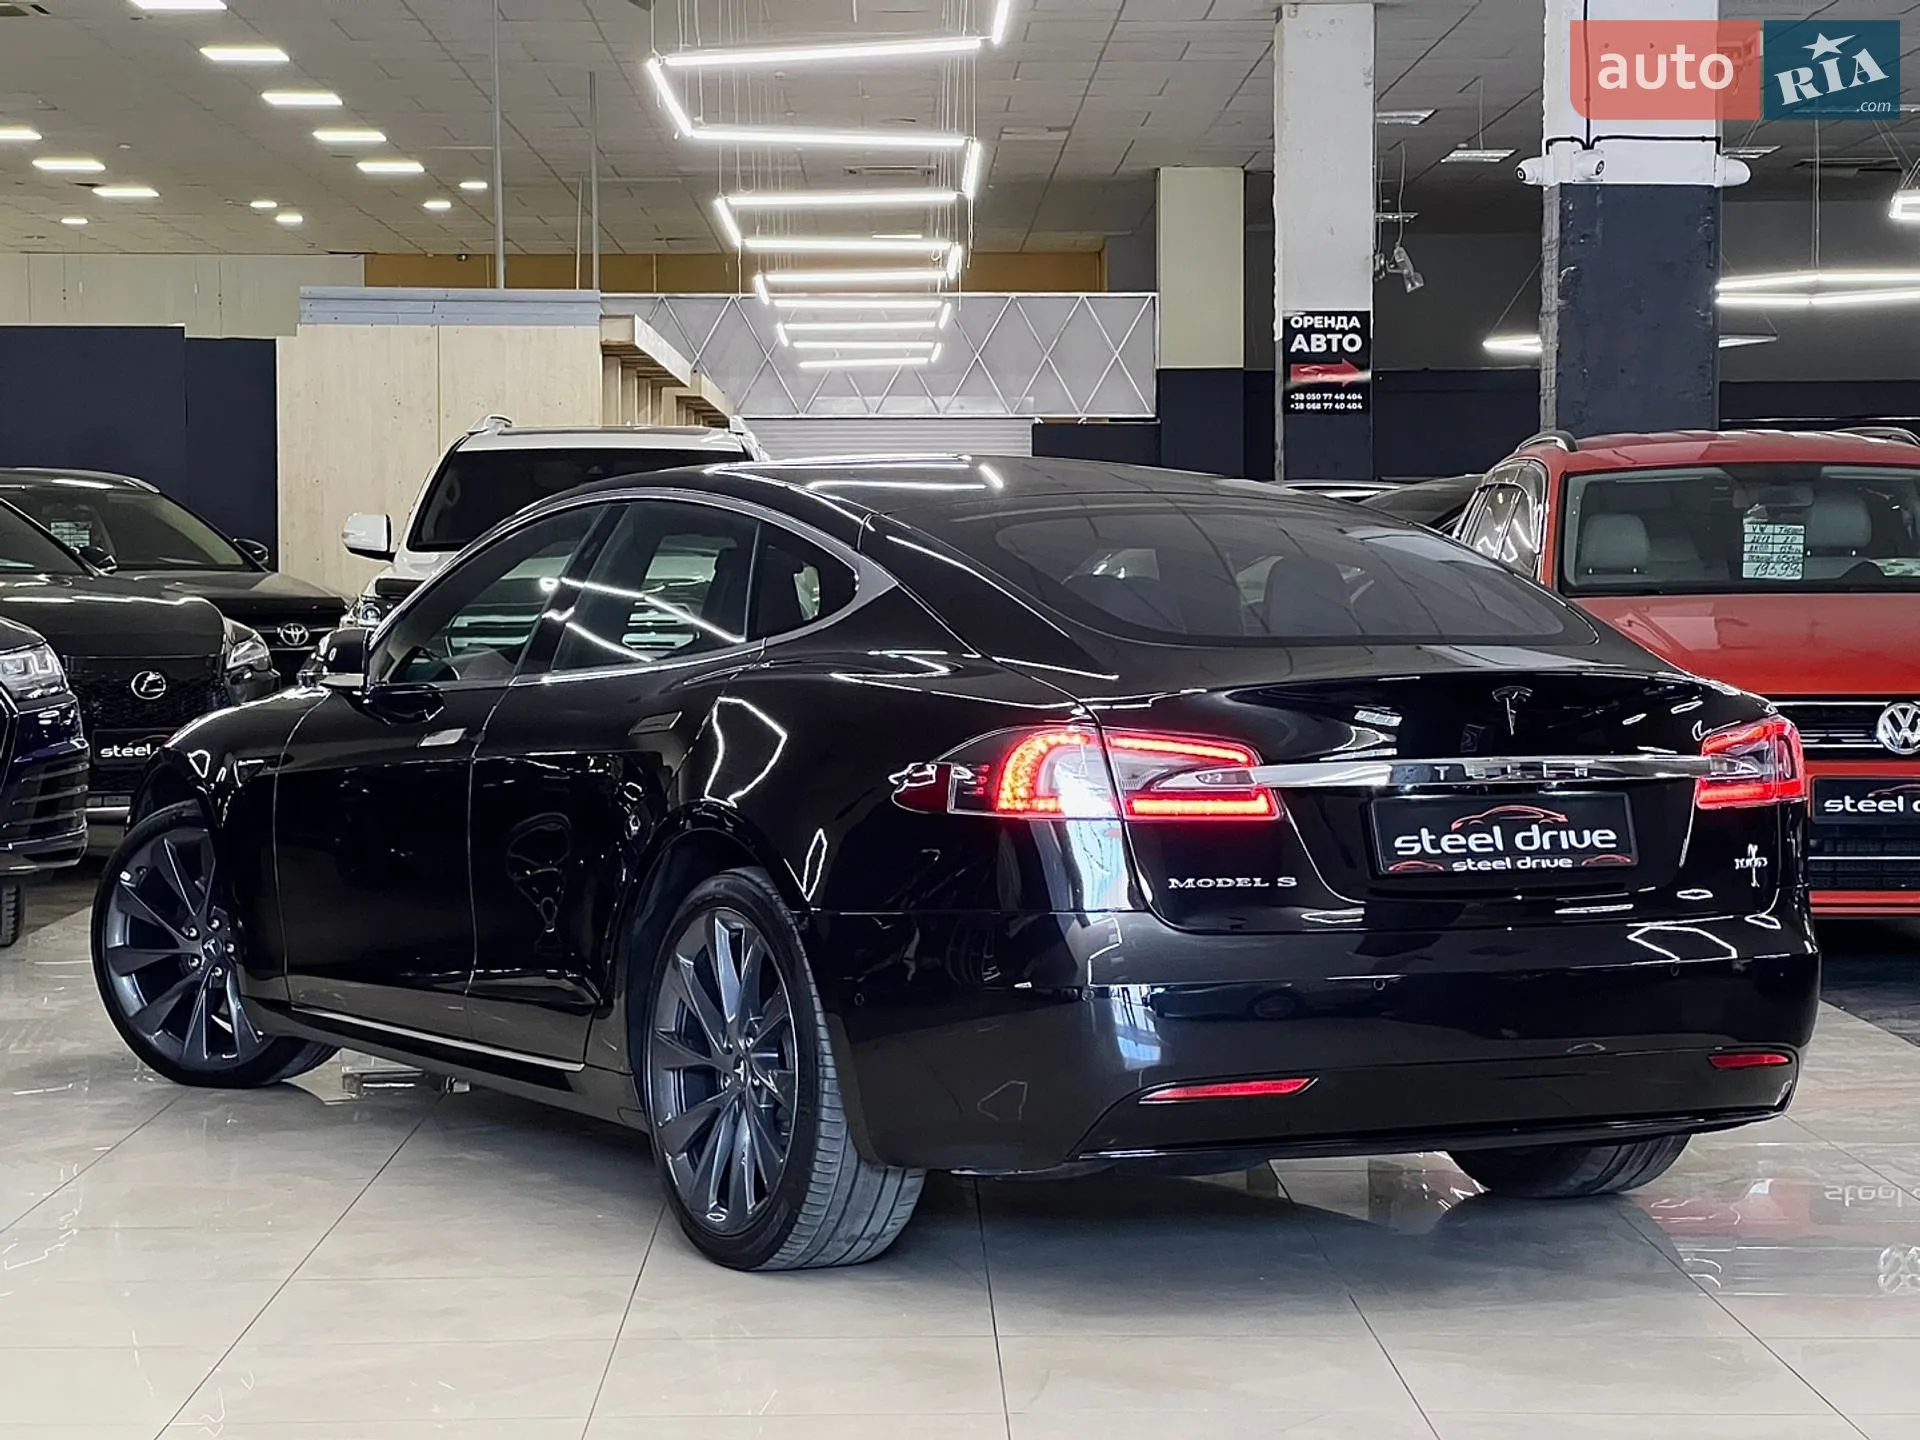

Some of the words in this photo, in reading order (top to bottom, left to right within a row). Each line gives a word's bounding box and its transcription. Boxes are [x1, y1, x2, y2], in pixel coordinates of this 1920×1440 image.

[1290, 315, 1361, 331] ОРЕНДА
[1290, 333, 1362, 353] АВТО
[1322, 392, 1333, 400] 77
[1323, 402, 1333, 410] 77
[100, 743, 150, 758] steel
[1433, 762, 1588, 782] TLA
[1824, 795, 1904, 813] steel
[1394, 825, 1504, 856] steel
[1514, 824, 1617, 851] drive
[1452, 857, 1511, 872] steel
[1516, 856, 1573, 870] drive
[1168, 877, 1270, 889] MODEL
[1277, 876, 1297, 887] S
